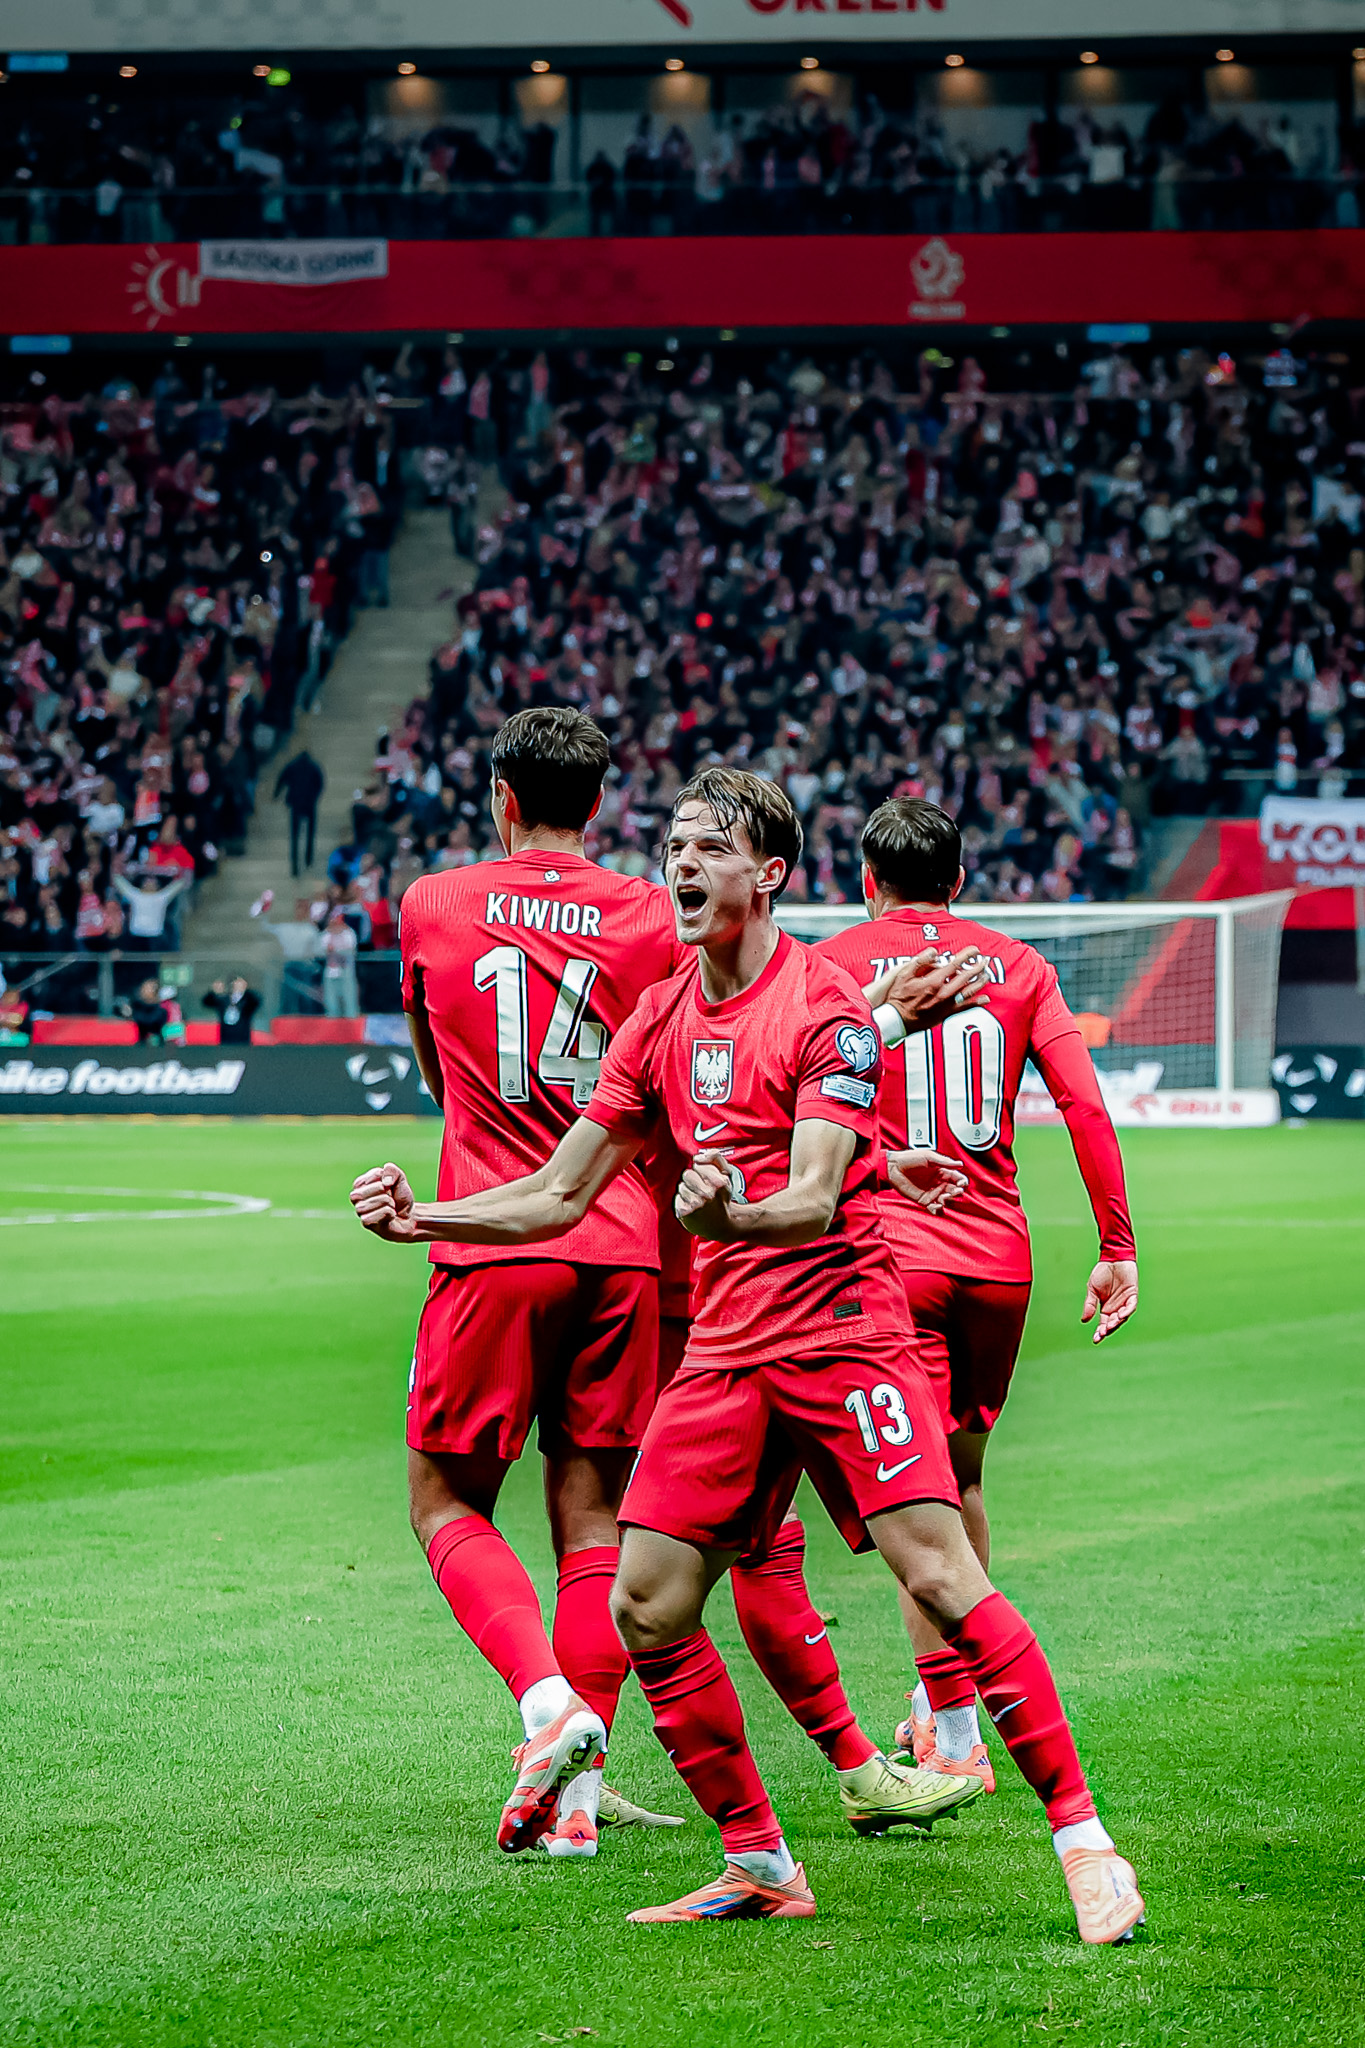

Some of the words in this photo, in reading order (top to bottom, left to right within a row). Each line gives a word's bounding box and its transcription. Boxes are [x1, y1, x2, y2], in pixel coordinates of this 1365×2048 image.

[485, 892, 601, 937] KIWIOR
[473, 945, 608, 1109] 14
[0, 1059, 69, 1094] ike
[69, 1059, 246, 1094] football
[886, 1006, 1006, 1152] 10
[844, 1382, 914, 1453] 13
